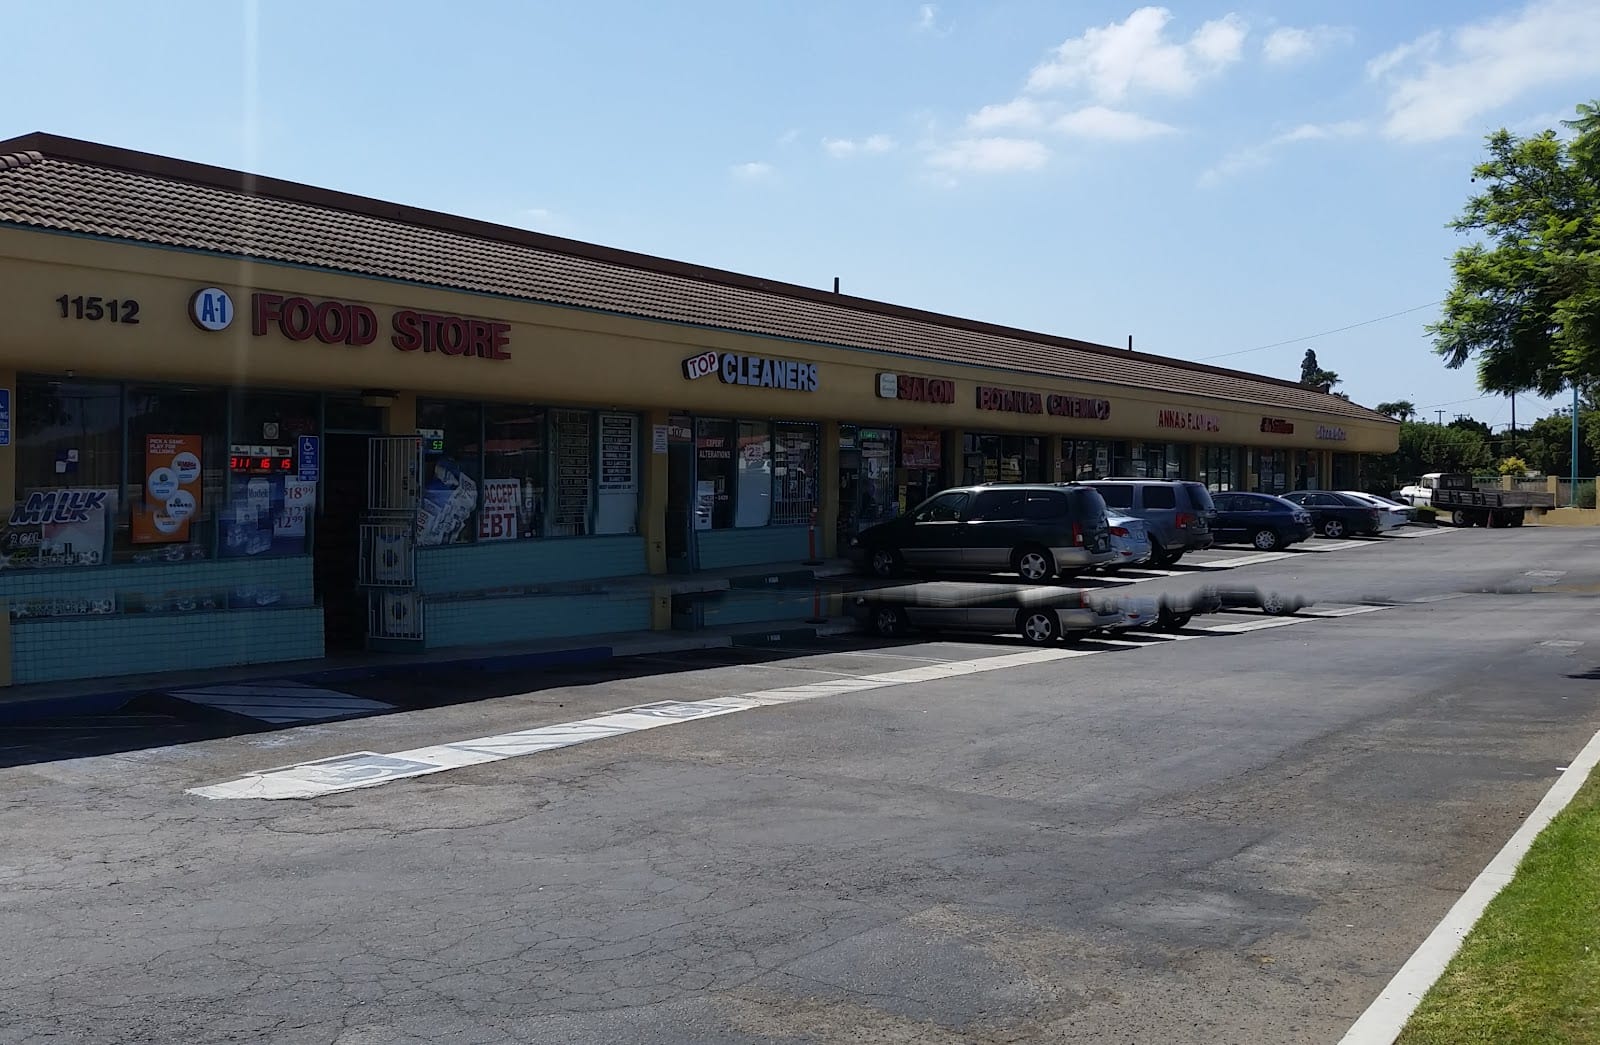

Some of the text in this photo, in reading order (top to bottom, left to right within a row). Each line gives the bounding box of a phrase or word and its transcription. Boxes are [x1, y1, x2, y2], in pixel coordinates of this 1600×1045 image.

[56, 294, 140, 324] 11512
[252, 292, 378, 345] FOOD
[392, 310, 512, 360] STORE
[690, 353, 818, 392] TOP CLEANERS
[898, 375, 955, 403] SALON
[672, 427, 684, 438] 107
[432, 440, 443, 450] 53
[260, 458, 271, 468] 16
[281, 458, 292, 469] 15
[25, 491, 107, 511] MILK
[484, 483, 518, 504] ACCEPT
[479, 513, 515, 538] EBT
